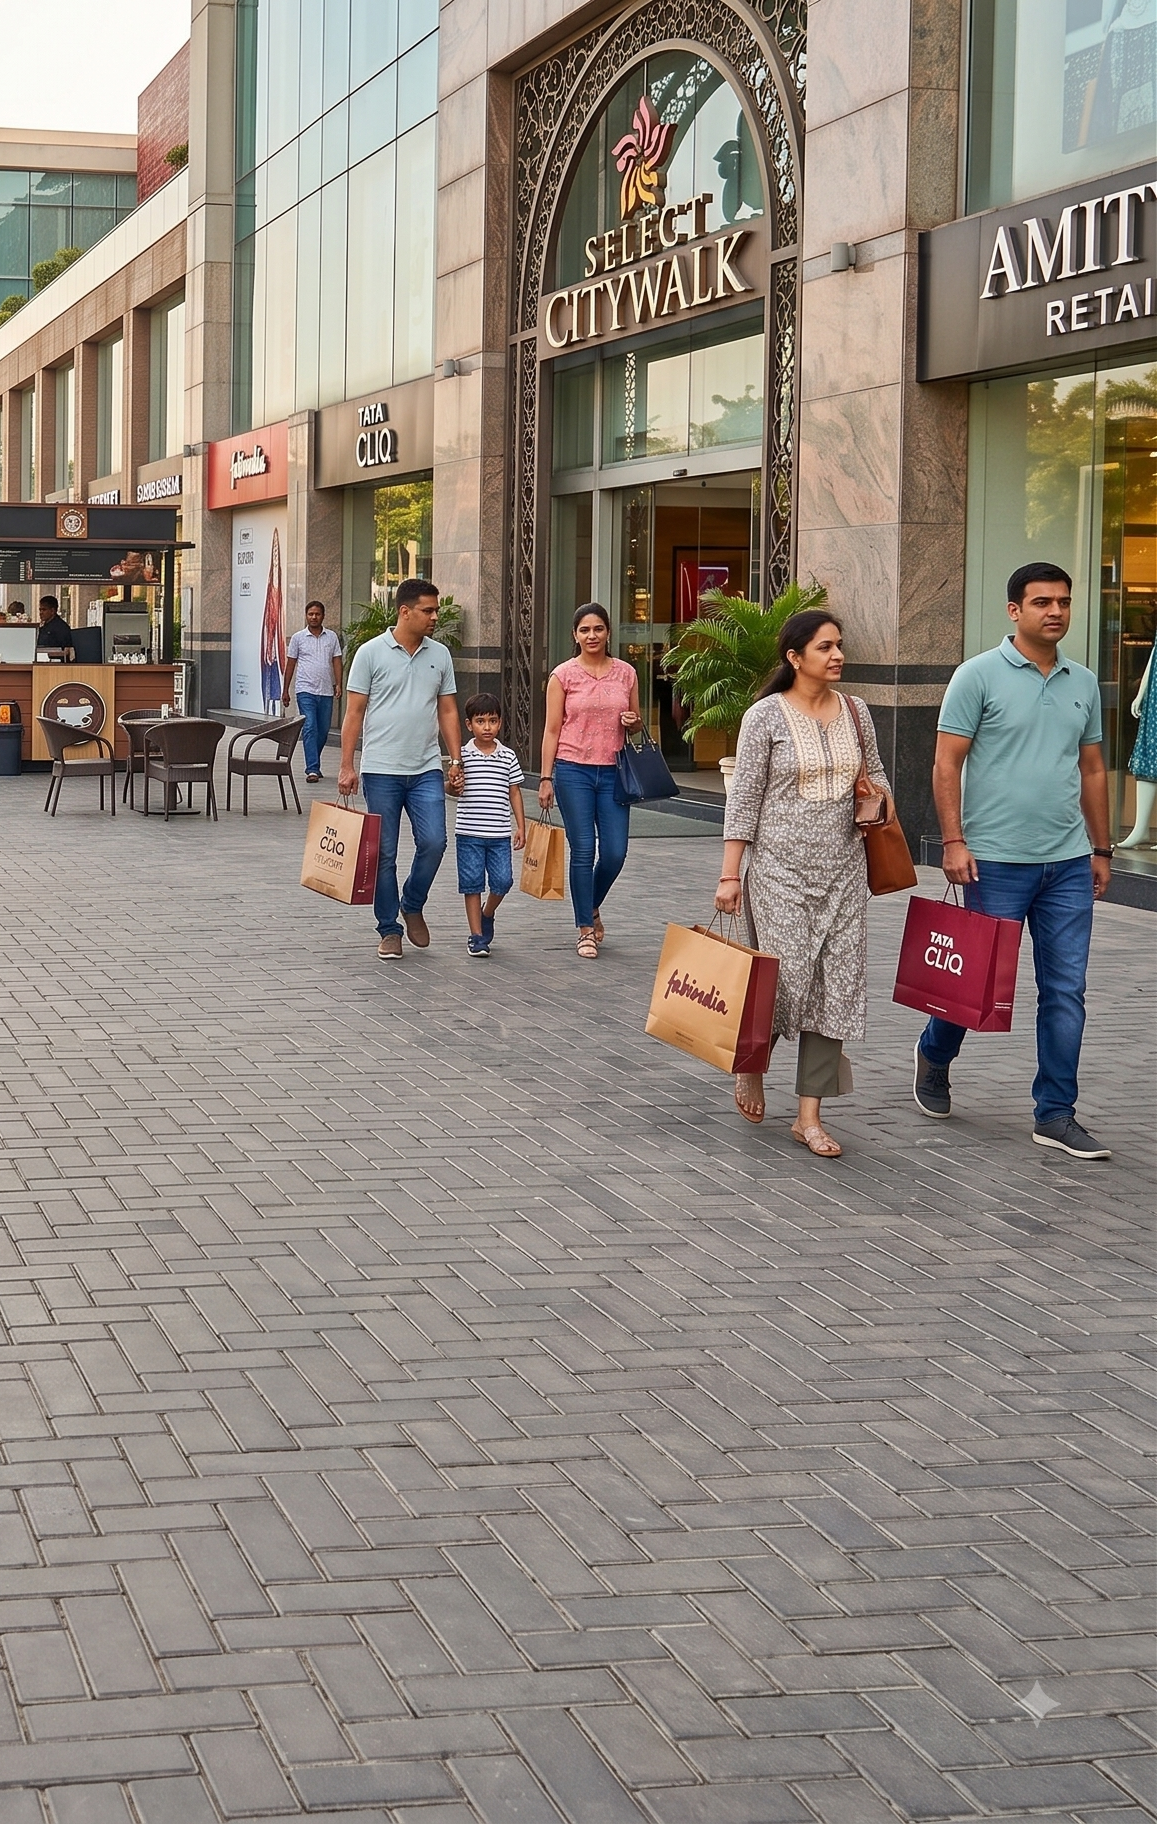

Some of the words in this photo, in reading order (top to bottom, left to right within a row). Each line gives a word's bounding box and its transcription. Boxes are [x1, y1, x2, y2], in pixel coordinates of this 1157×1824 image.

[584, 193, 711, 277] SELECT
[980, 181, 1157, 299] AMIT
[545, 230, 749, 348] CITYWALK
[357, 403, 384, 427] TATA
[355, 428, 392, 468] CLIQ
[930, 931, 954, 949] TATA
